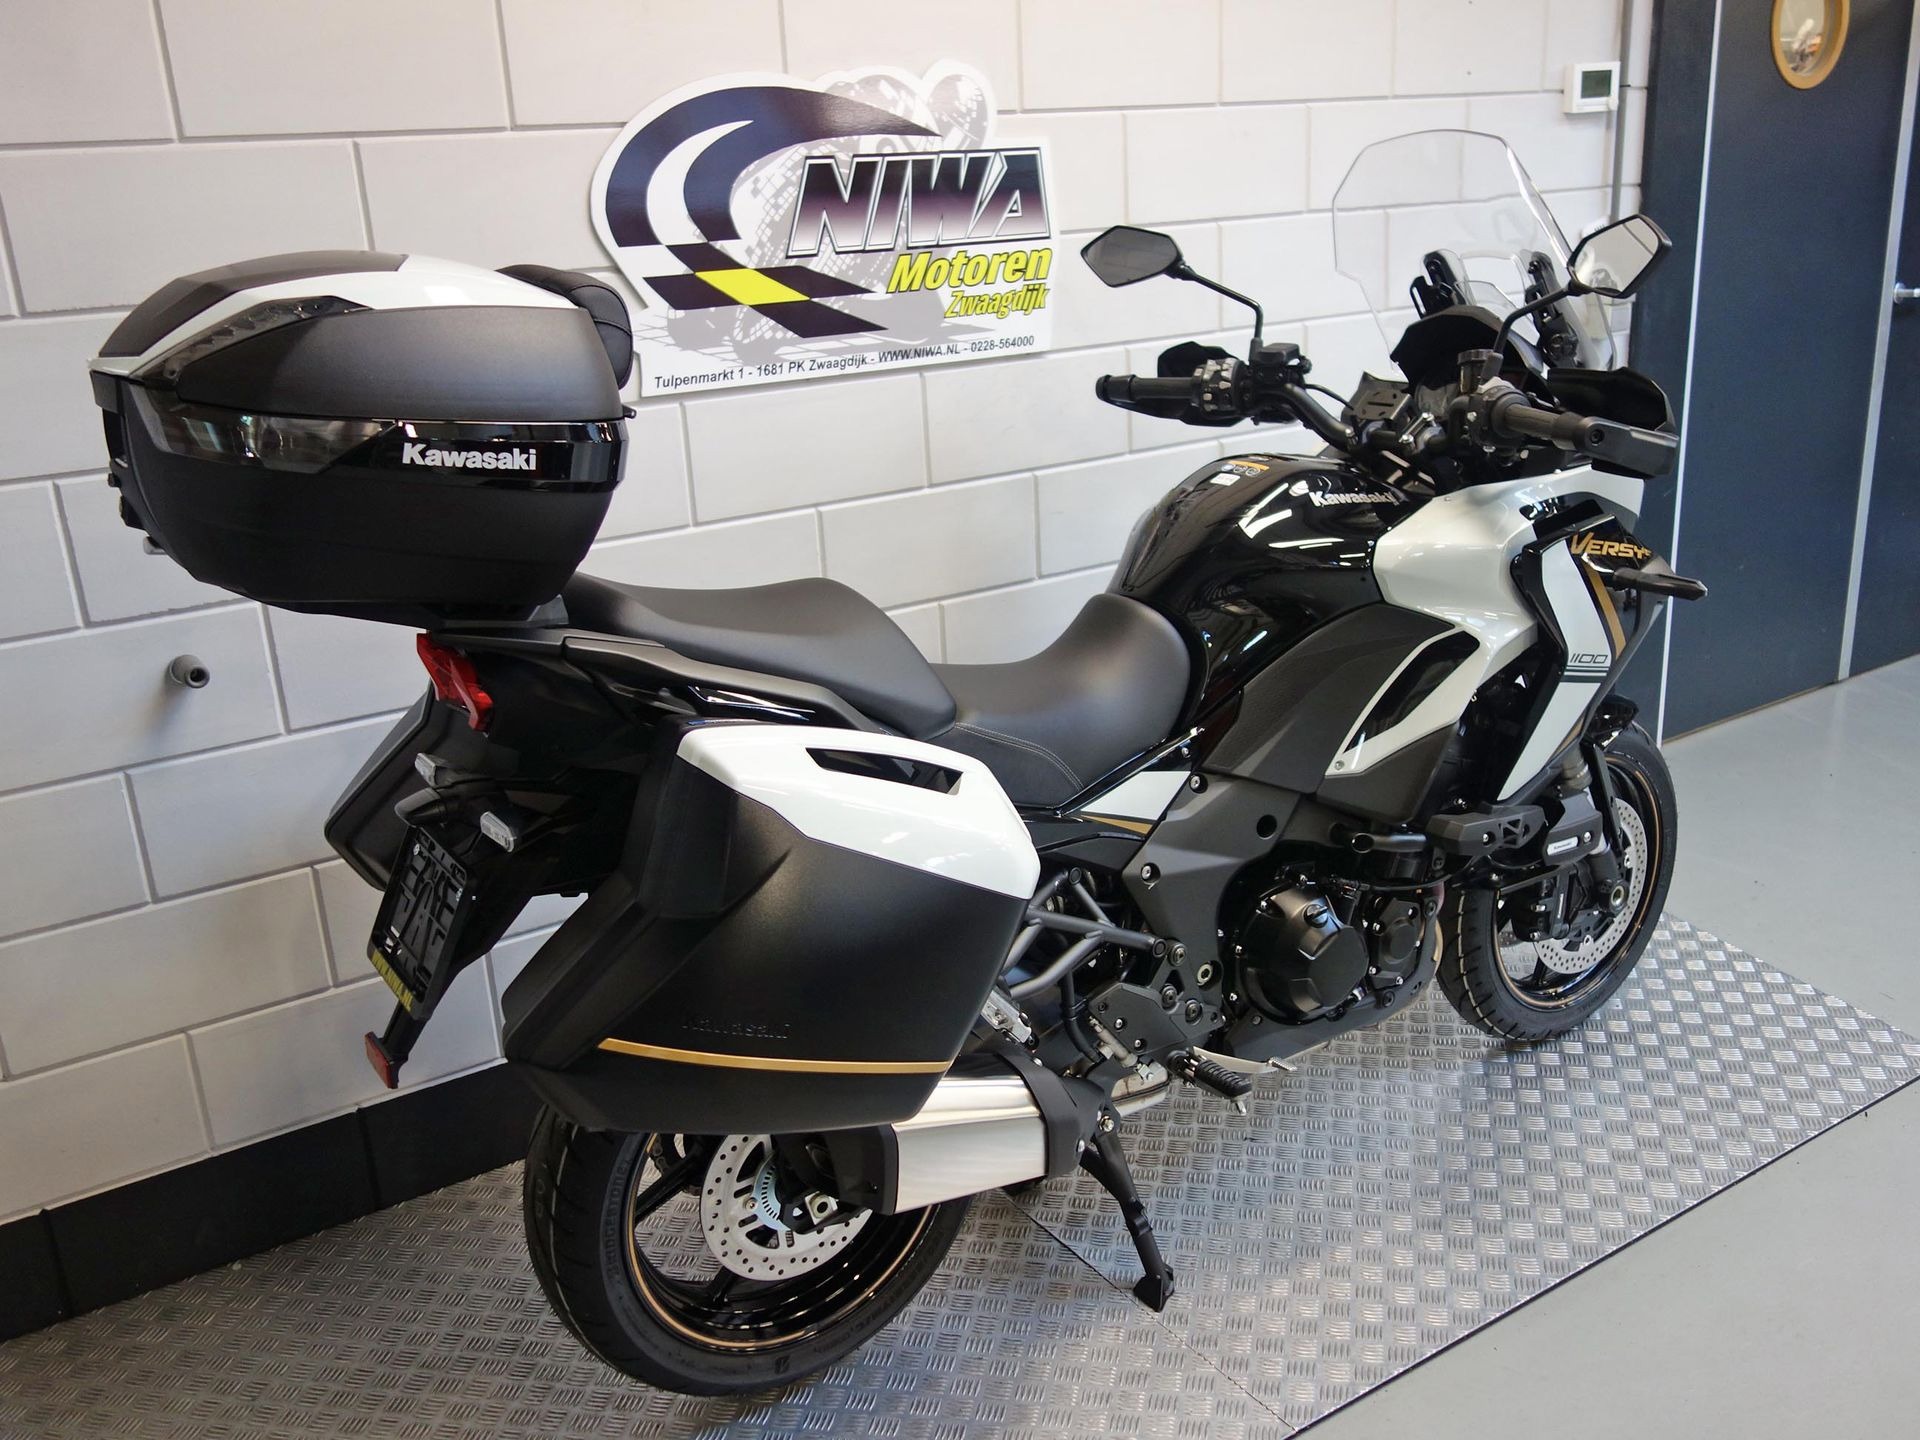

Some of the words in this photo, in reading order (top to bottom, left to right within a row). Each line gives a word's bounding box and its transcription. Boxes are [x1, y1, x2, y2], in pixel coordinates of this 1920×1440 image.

[786, 147, 1052, 259] NIWA
[886, 248, 1053, 294] Motoren
[944, 283, 1050, 319] Zwaagdijk
[654, 369, 734, 389] Tulpenmarkt
[738, 367, 745, 379] 1
[756, 364, 784, 377] 1681
[788, 360, 806, 372] PK
[809, 352, 868, 371] Zwaagdijk
[878, 343, 961, 363] WWW.NIWA.NL
[970, 335, 1035, 353] 0228-564000
[402, 442, 537, 471] Kawasaki
[1570, 652, 1609, 664] 1100
